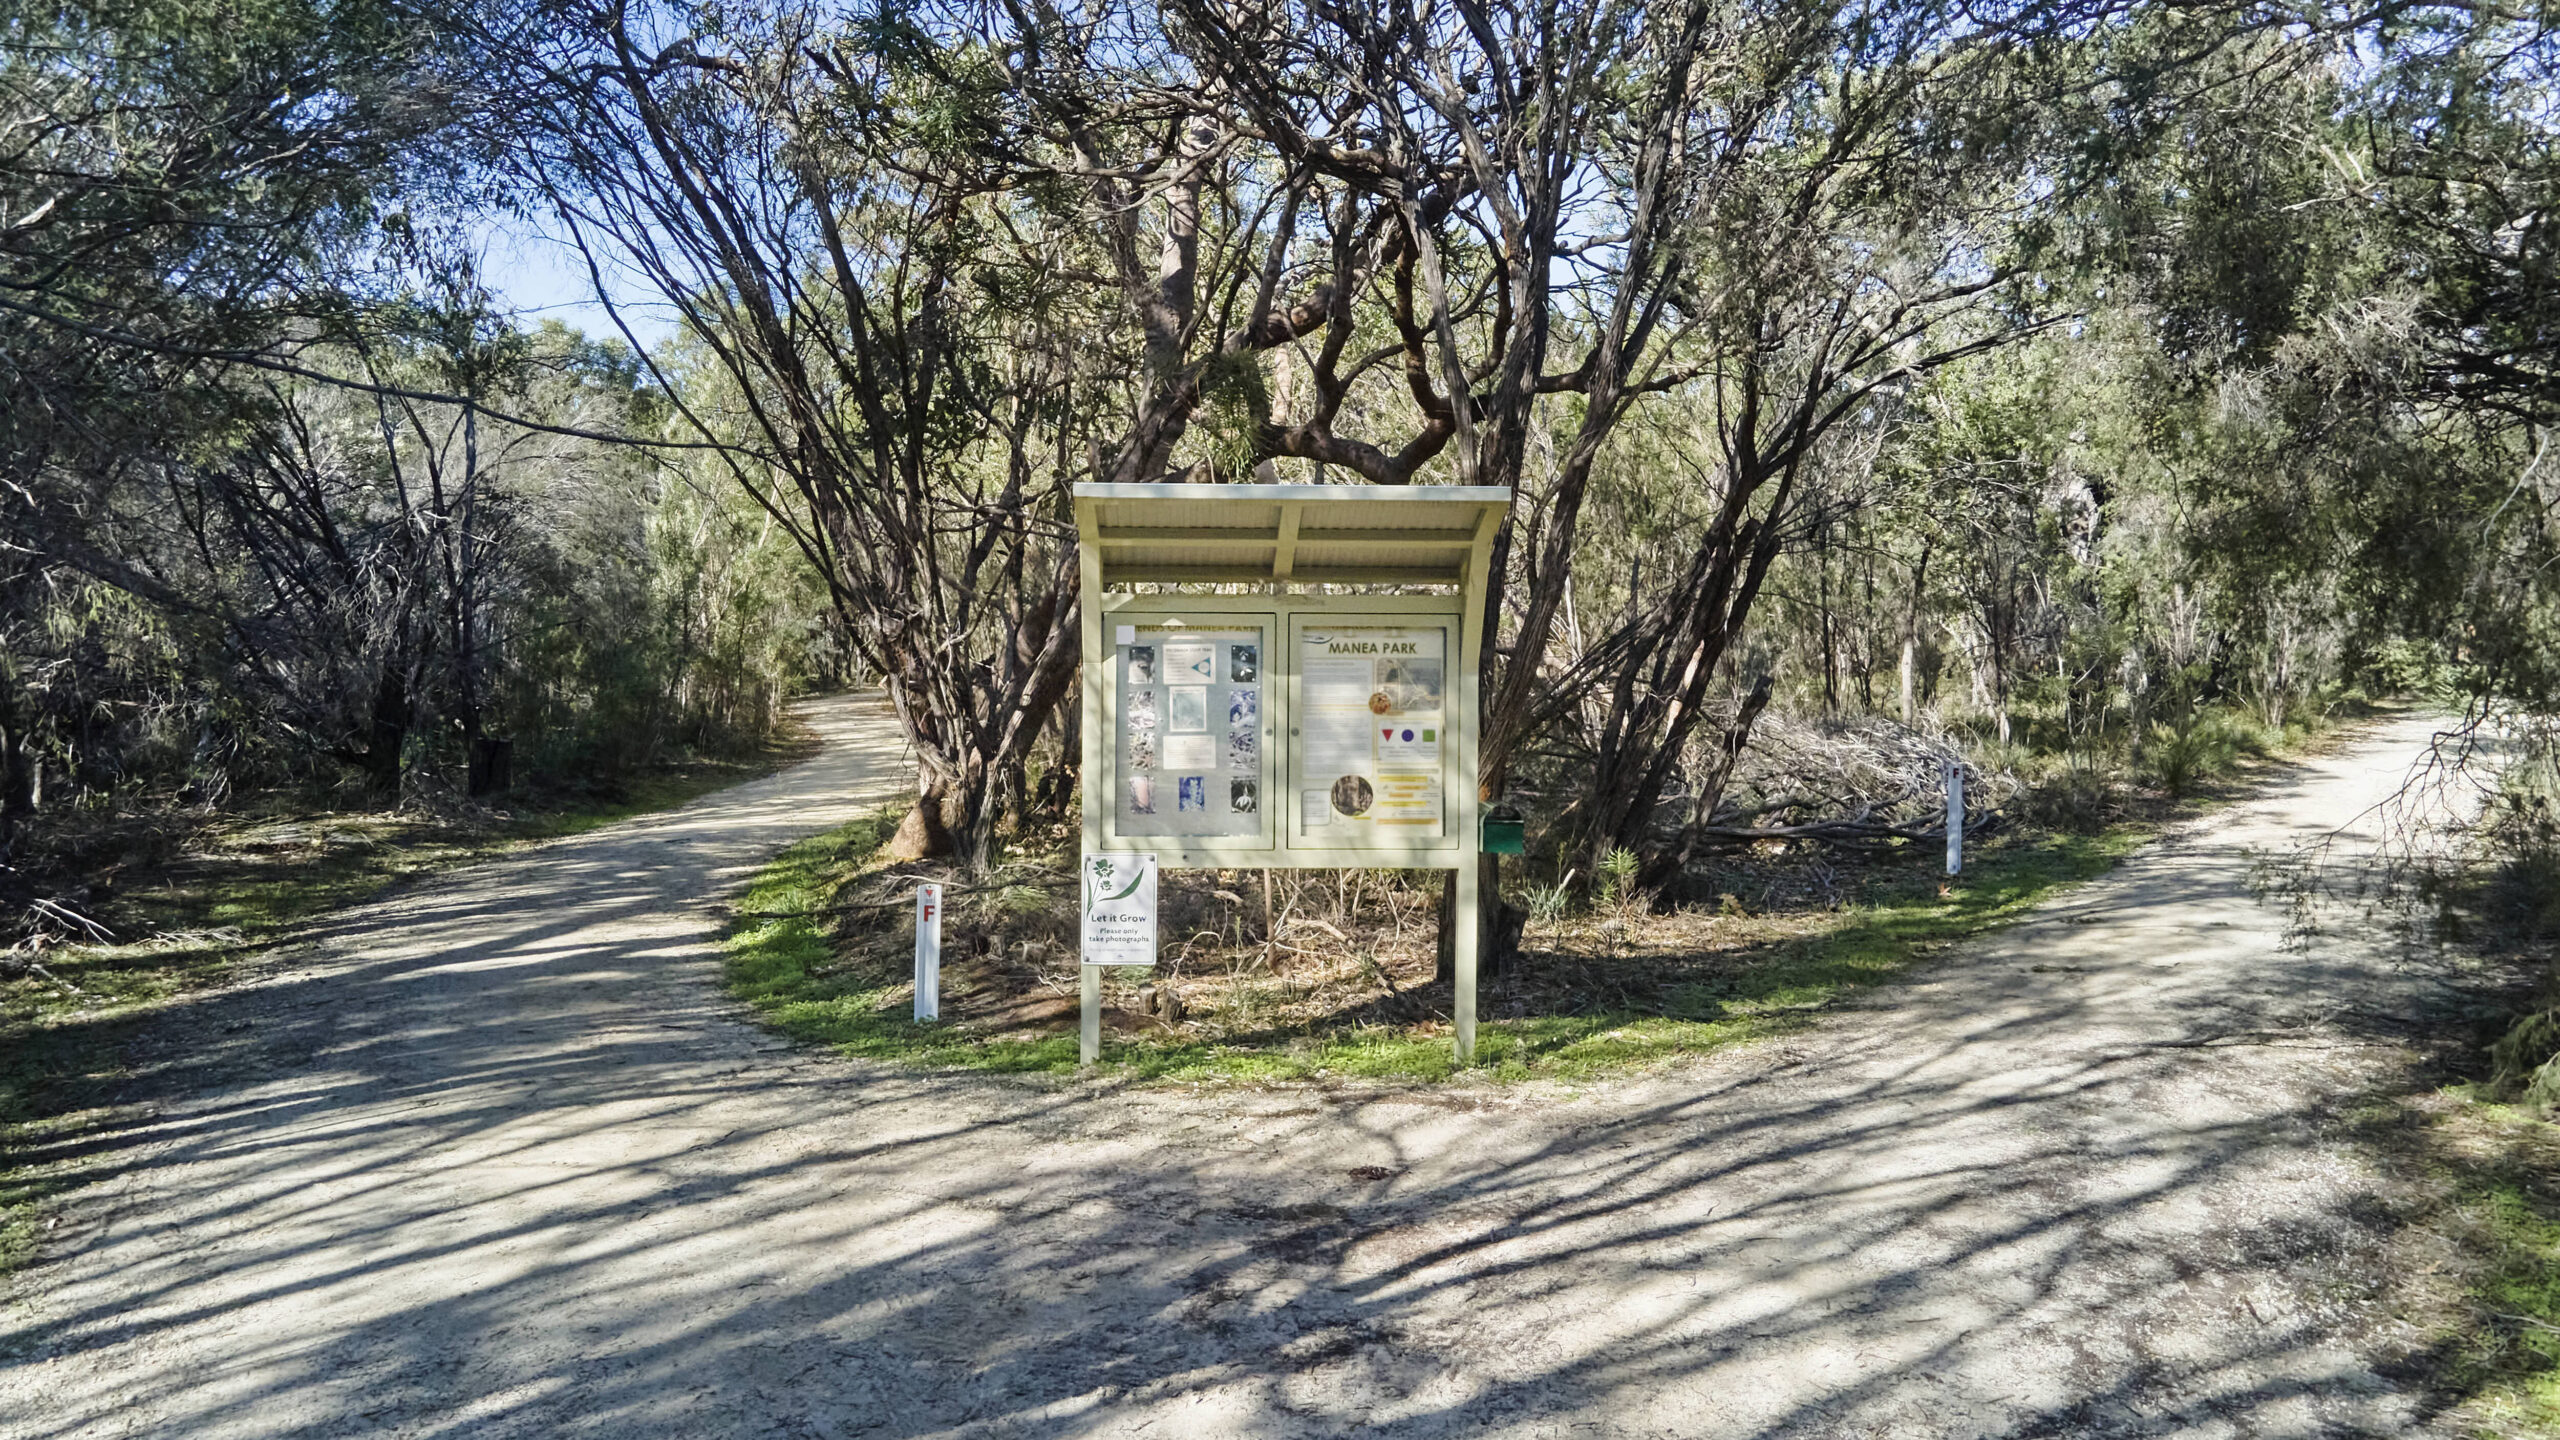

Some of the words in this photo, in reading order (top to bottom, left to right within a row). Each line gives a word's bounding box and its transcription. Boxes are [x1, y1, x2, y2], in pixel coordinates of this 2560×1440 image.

[1328, 642, 1378, 654] MANEA
[1383, 642, 1417, 654] PARK
[1953, 767, 1960, 779] F
[924, 905, 935, 922] F
[1091, 914, 1107, 922] Let
[1109, 914, 1117, 922] it
[1119, 914, 1146, 922] Grow
